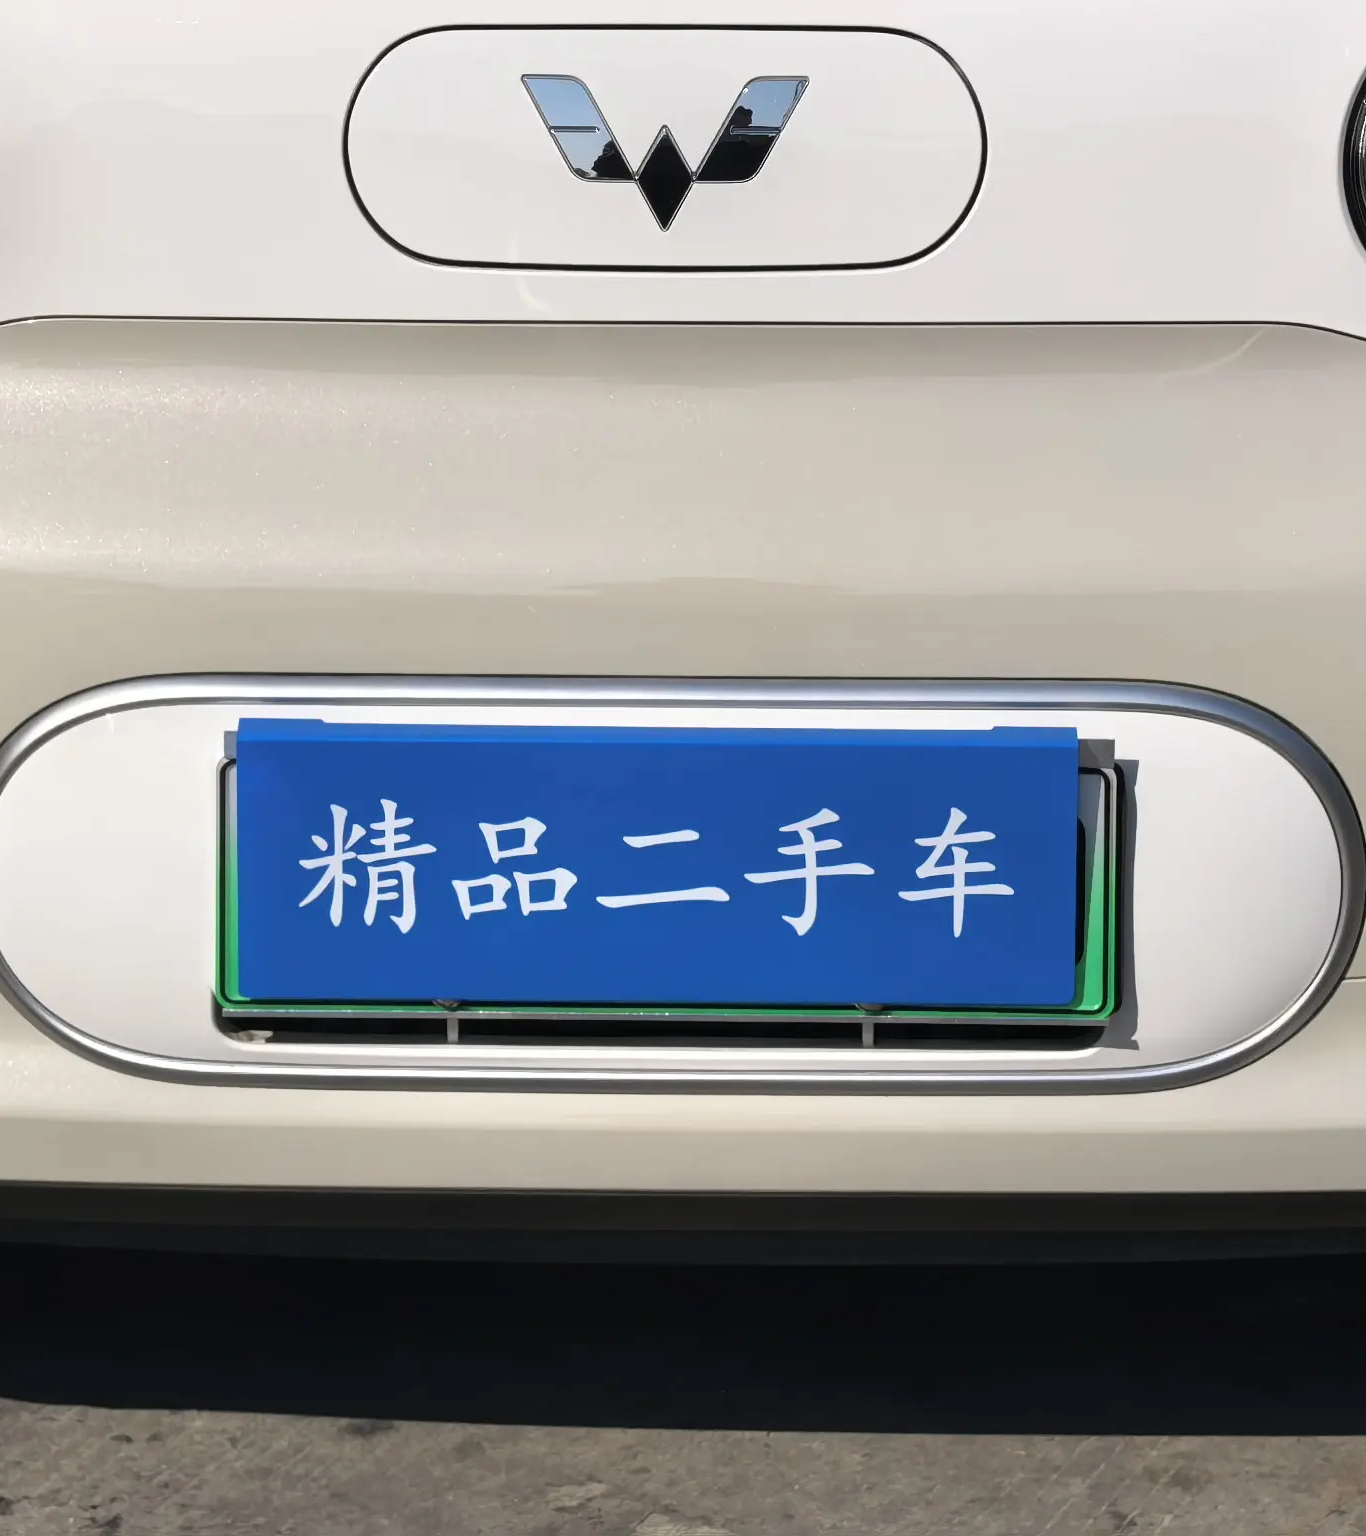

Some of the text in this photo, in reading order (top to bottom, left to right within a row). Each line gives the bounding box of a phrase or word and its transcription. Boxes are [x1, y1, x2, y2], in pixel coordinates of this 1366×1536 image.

[298, 798, 1015, 938] 精品二手车
